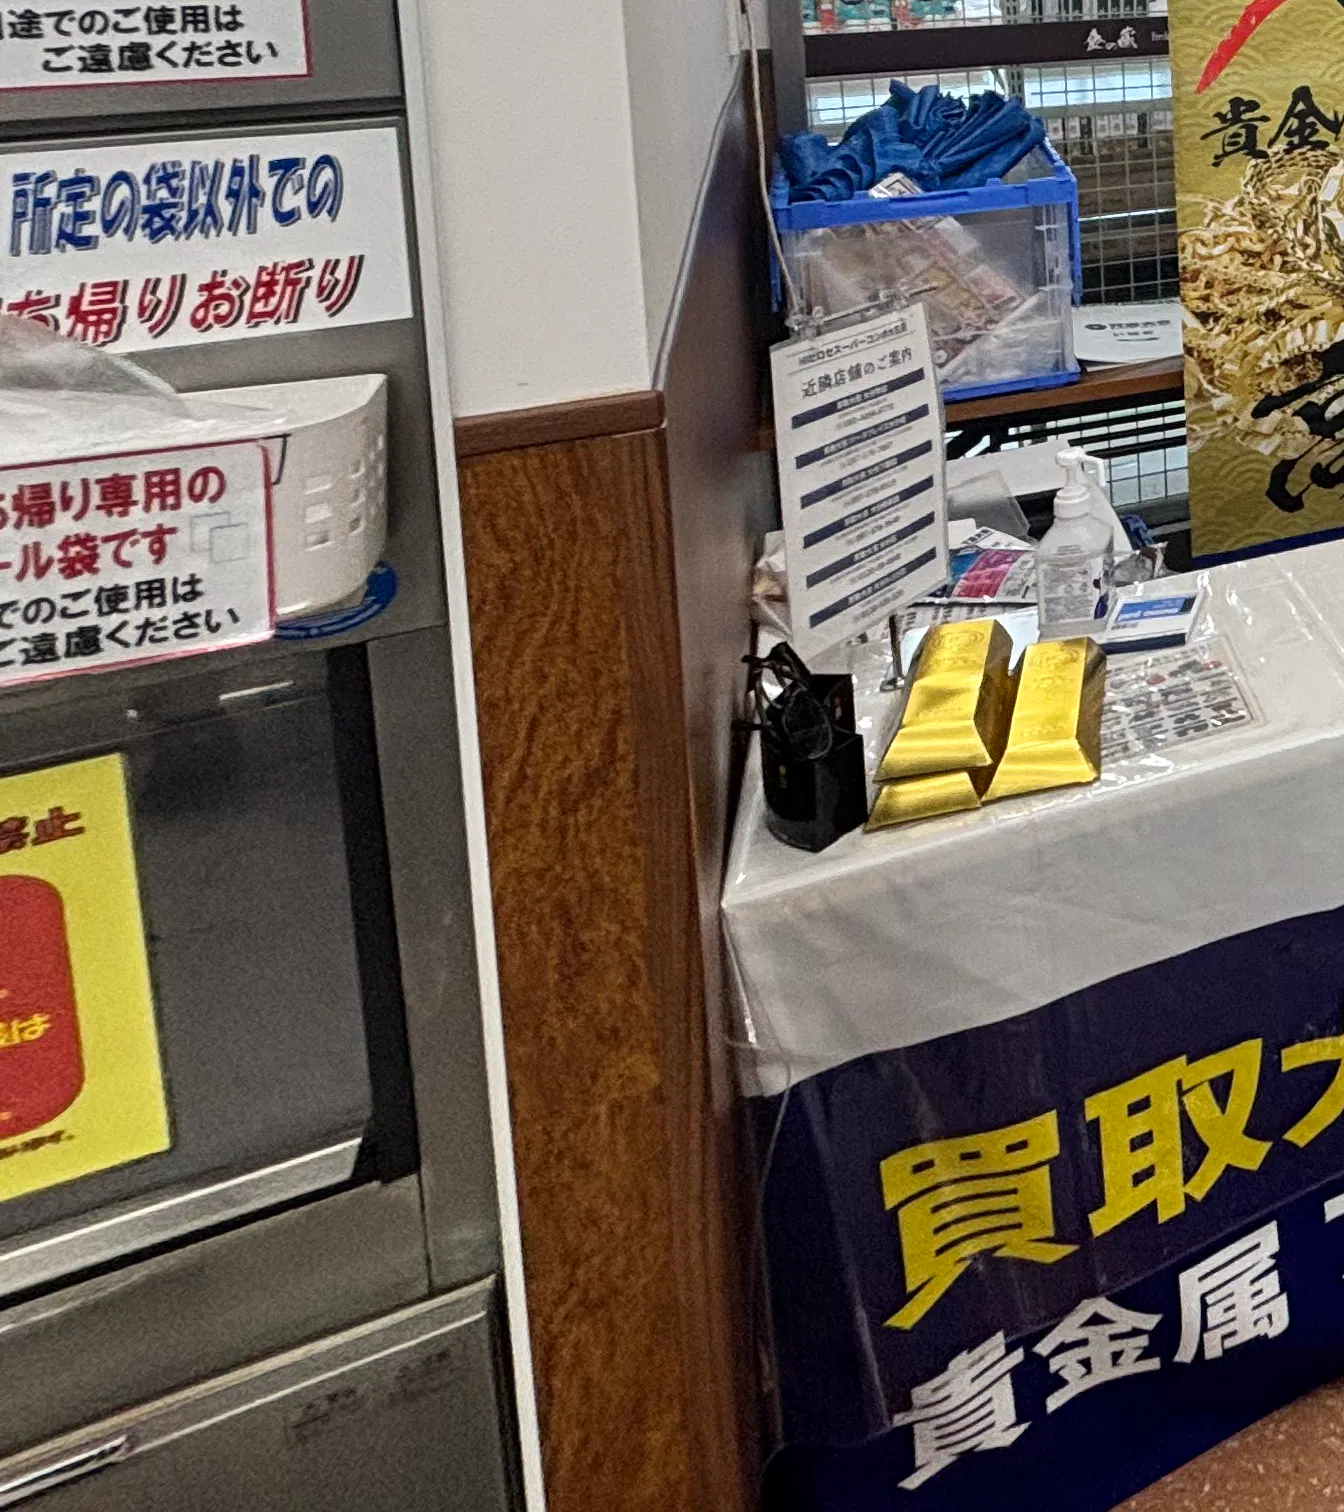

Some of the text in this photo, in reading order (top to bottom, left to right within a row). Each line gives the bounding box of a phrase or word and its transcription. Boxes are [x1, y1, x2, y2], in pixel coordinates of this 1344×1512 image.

[0, 5, 244, 40] 途でのご使用は
[42, 40, 279, 74] ご遠慮ください
[9, 154, 346, 256] 所定の袋以外での
[0, 255, 365, 347] ち帰りお断り
[891, 1220, 1290, 1491] 貴金属
